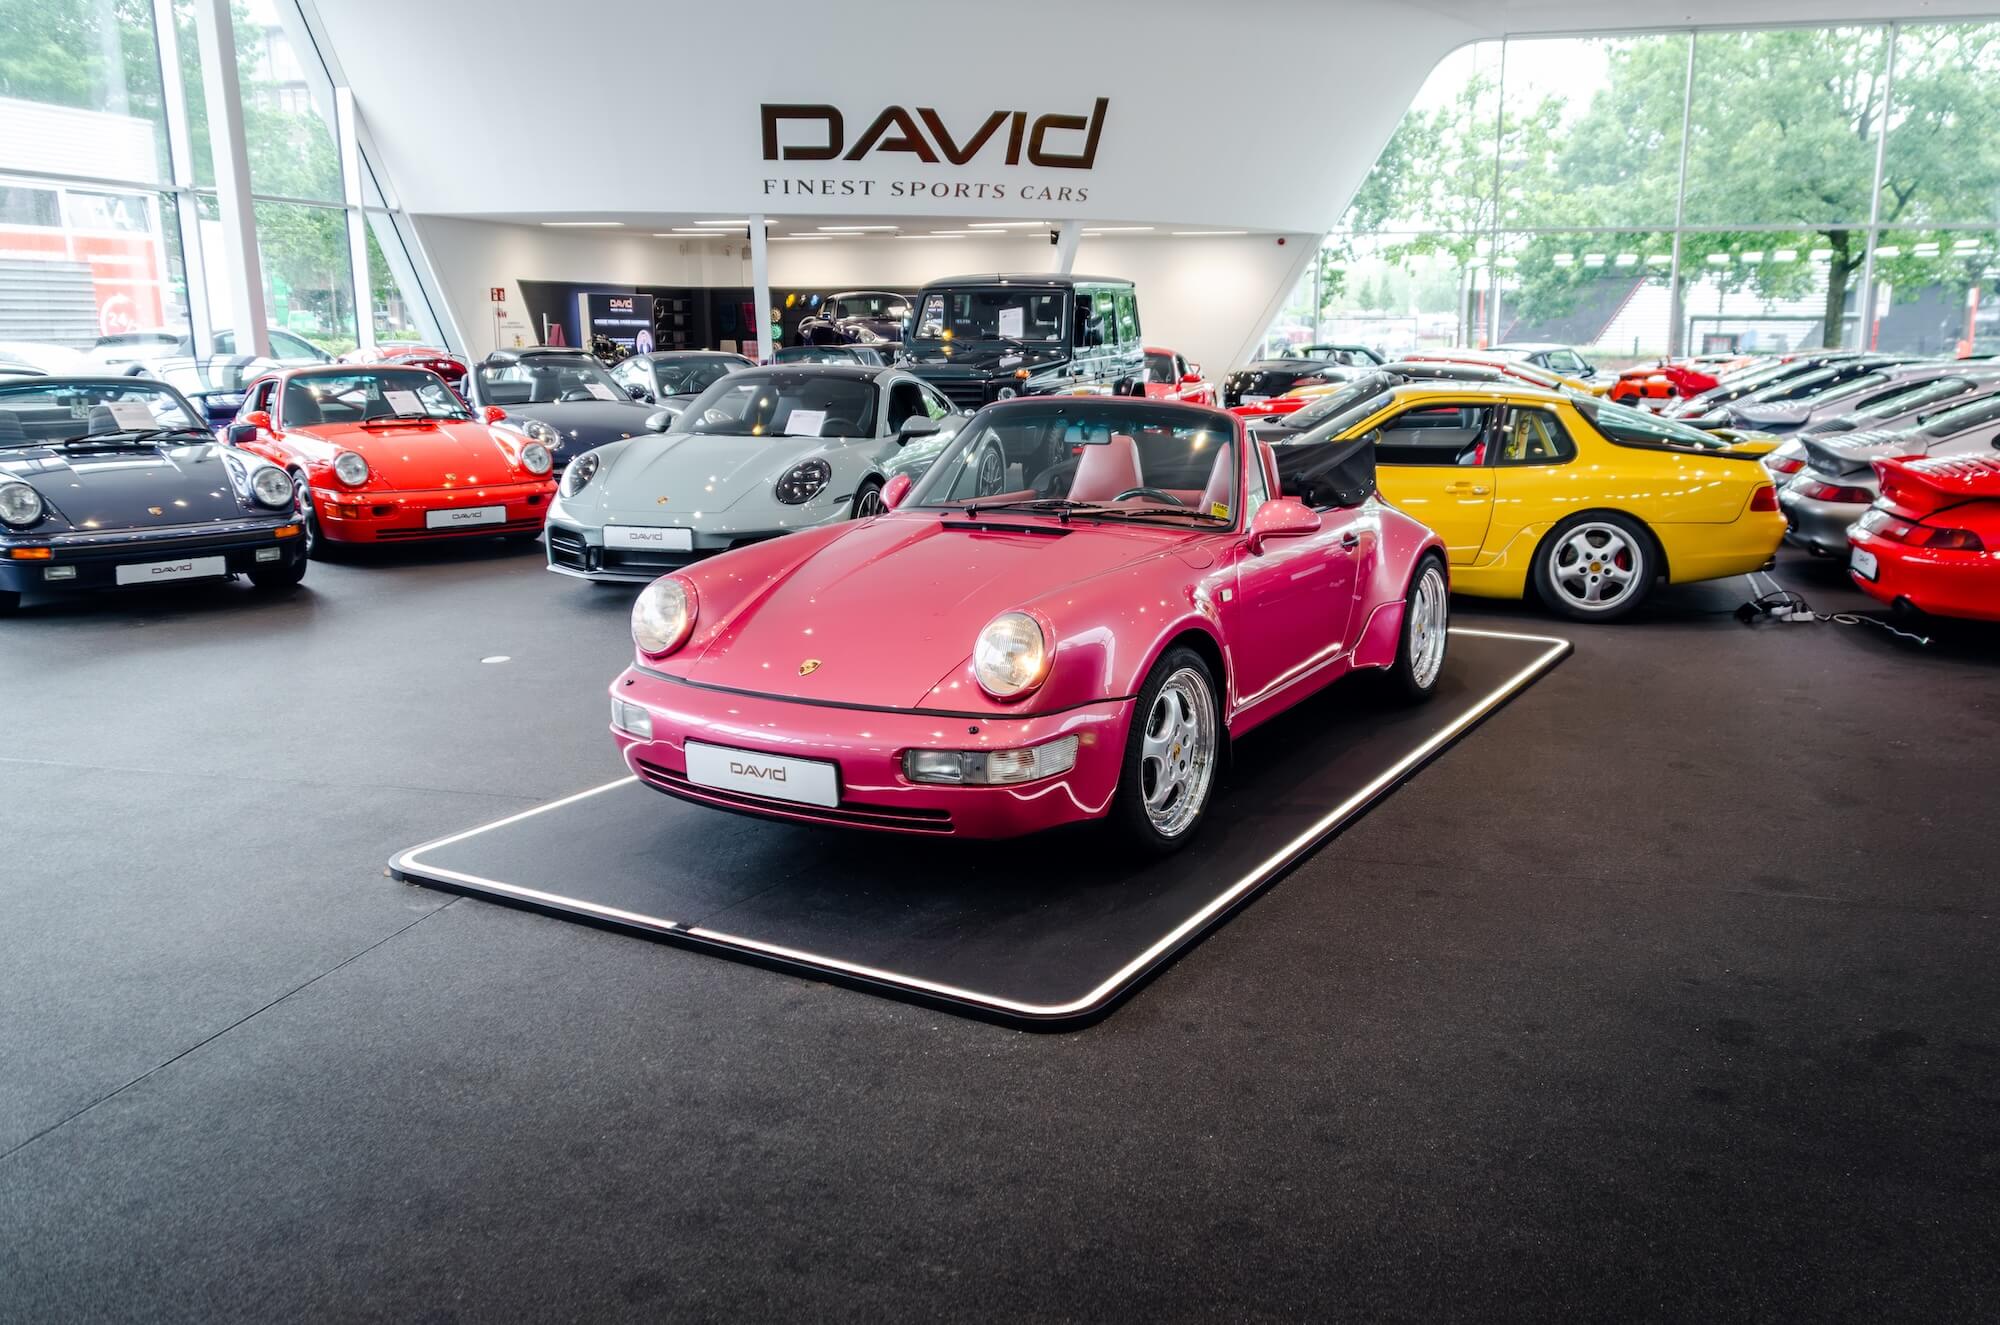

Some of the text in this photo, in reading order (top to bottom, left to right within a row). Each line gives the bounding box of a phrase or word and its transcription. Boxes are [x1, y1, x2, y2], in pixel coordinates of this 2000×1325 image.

[763, 179, 1089, 203] FINEST SPORTS CARS
